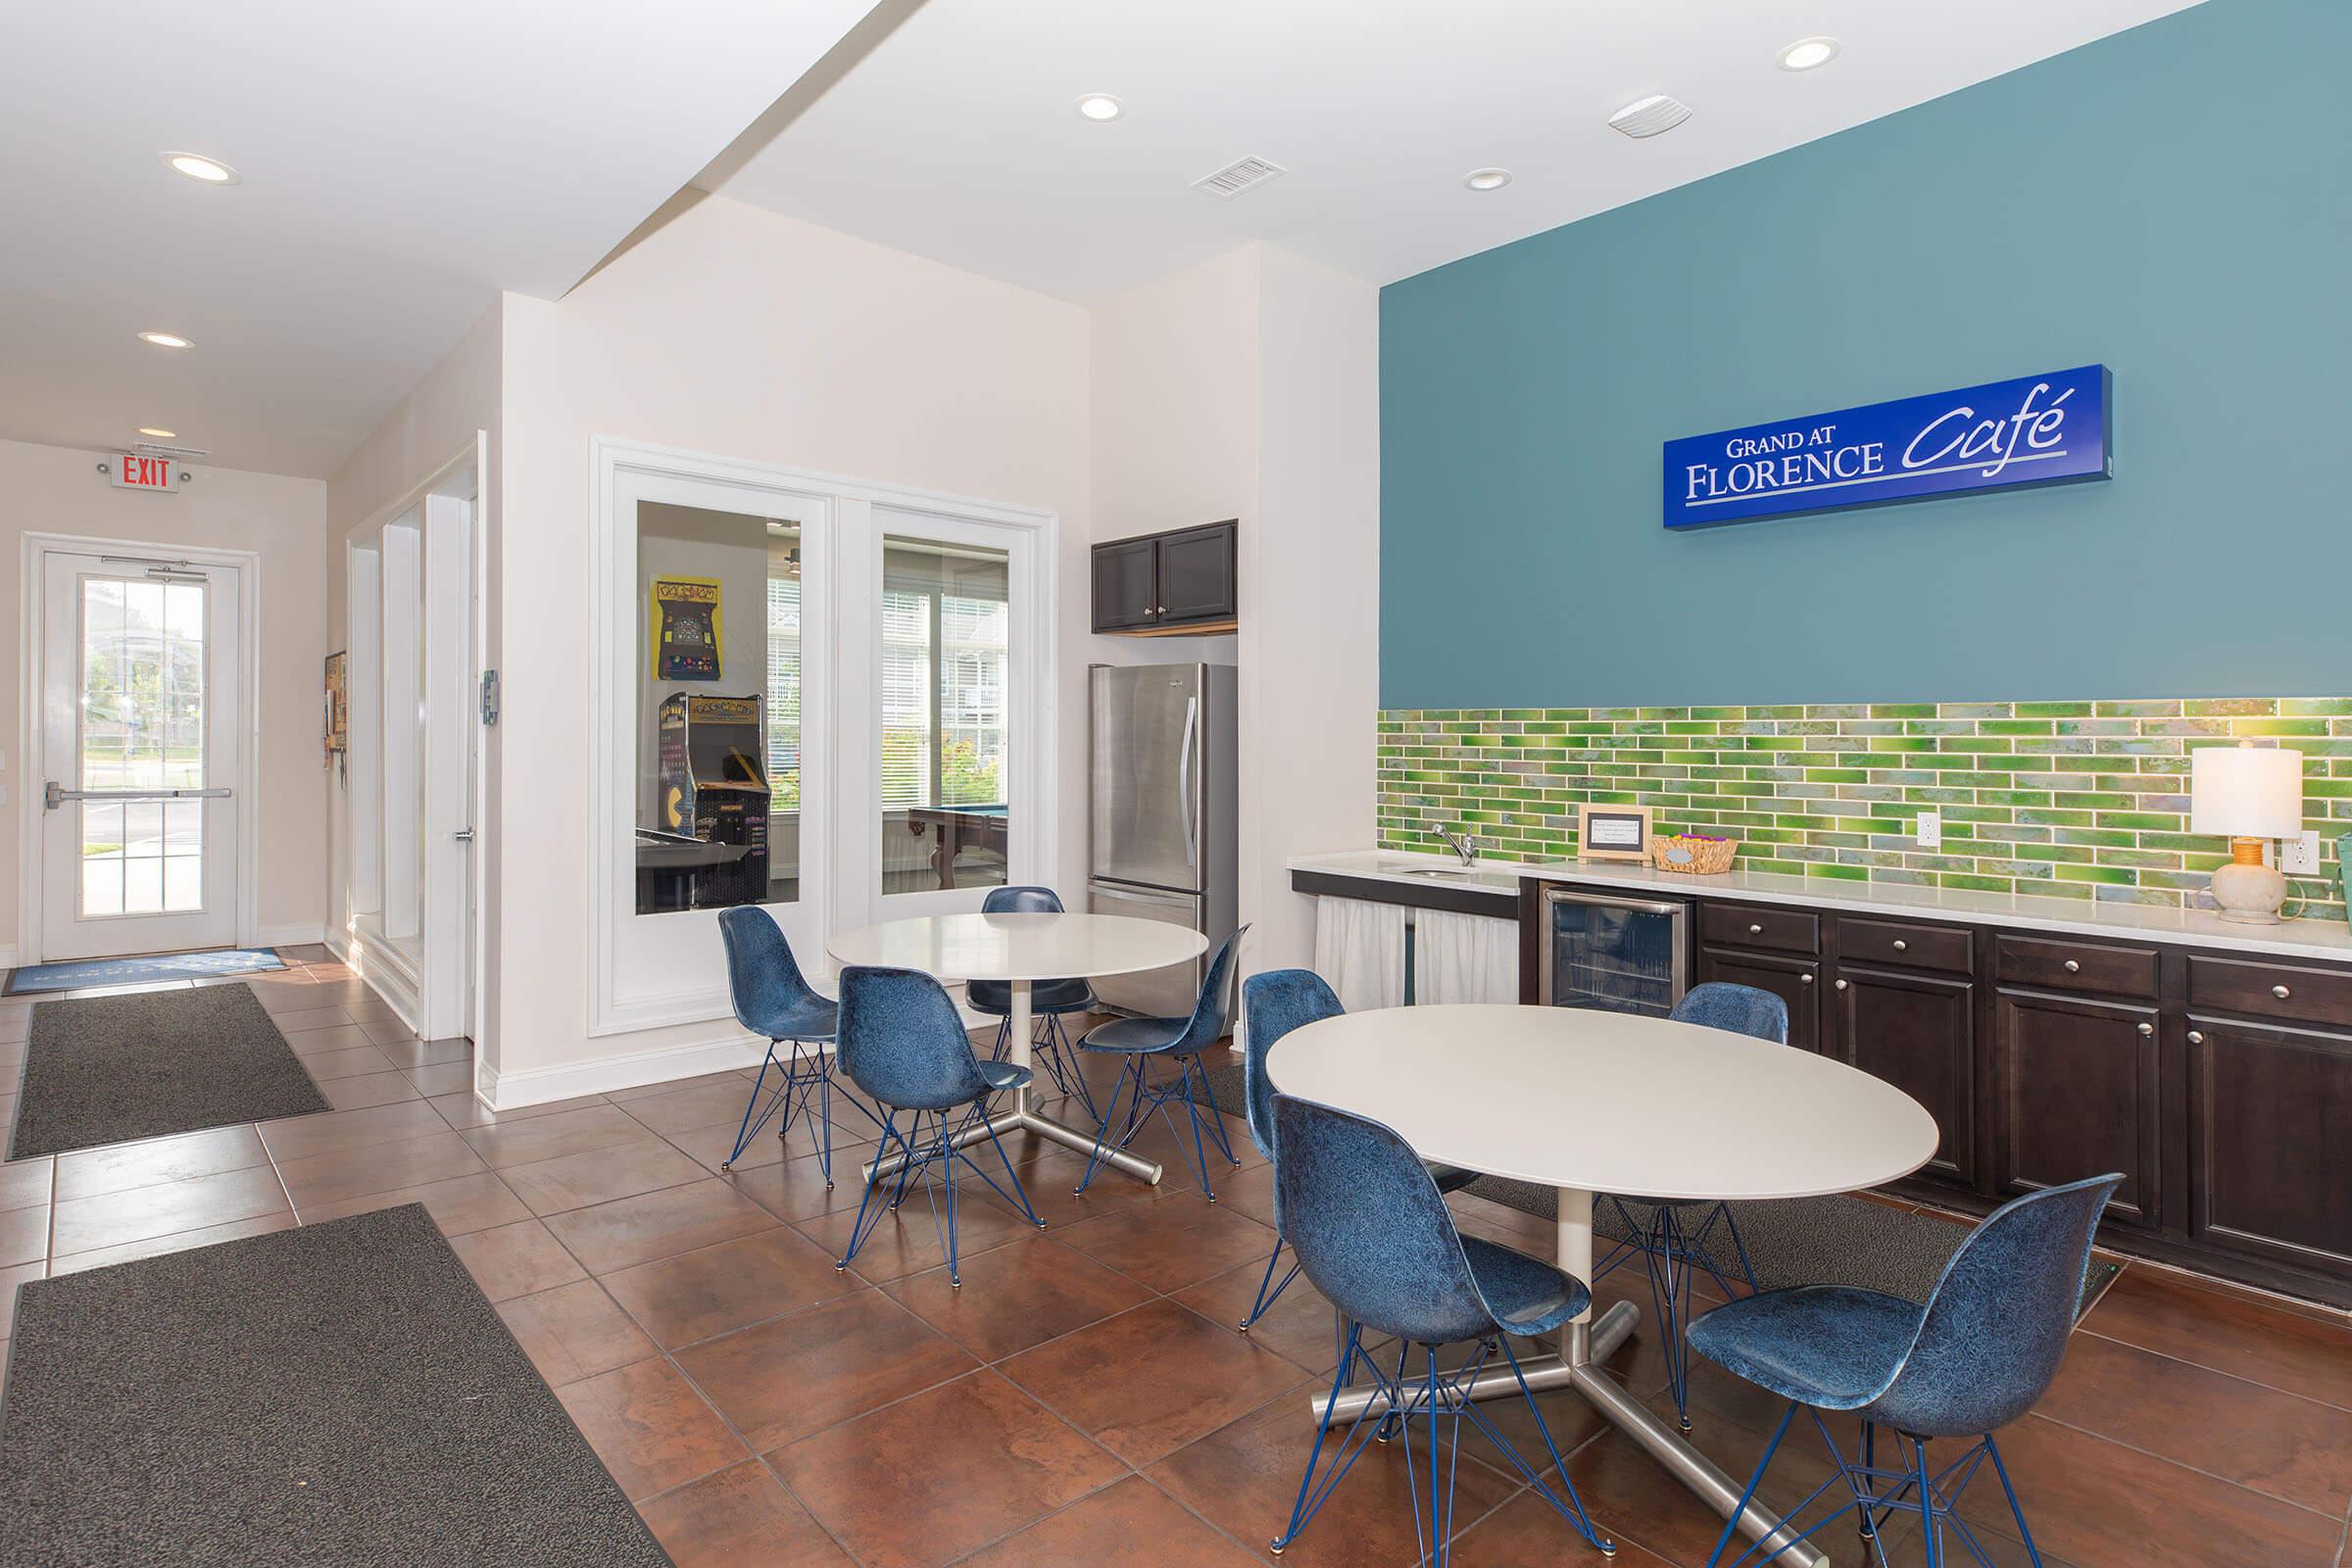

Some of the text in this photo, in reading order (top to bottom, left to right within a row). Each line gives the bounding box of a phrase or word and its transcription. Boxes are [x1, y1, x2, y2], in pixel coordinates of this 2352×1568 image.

[1686, 383, 2075, 499] FLORENCE Café
[1727, 425, 1837, 458] GRAND AT
[123, 456, 170, 487] EXIT
